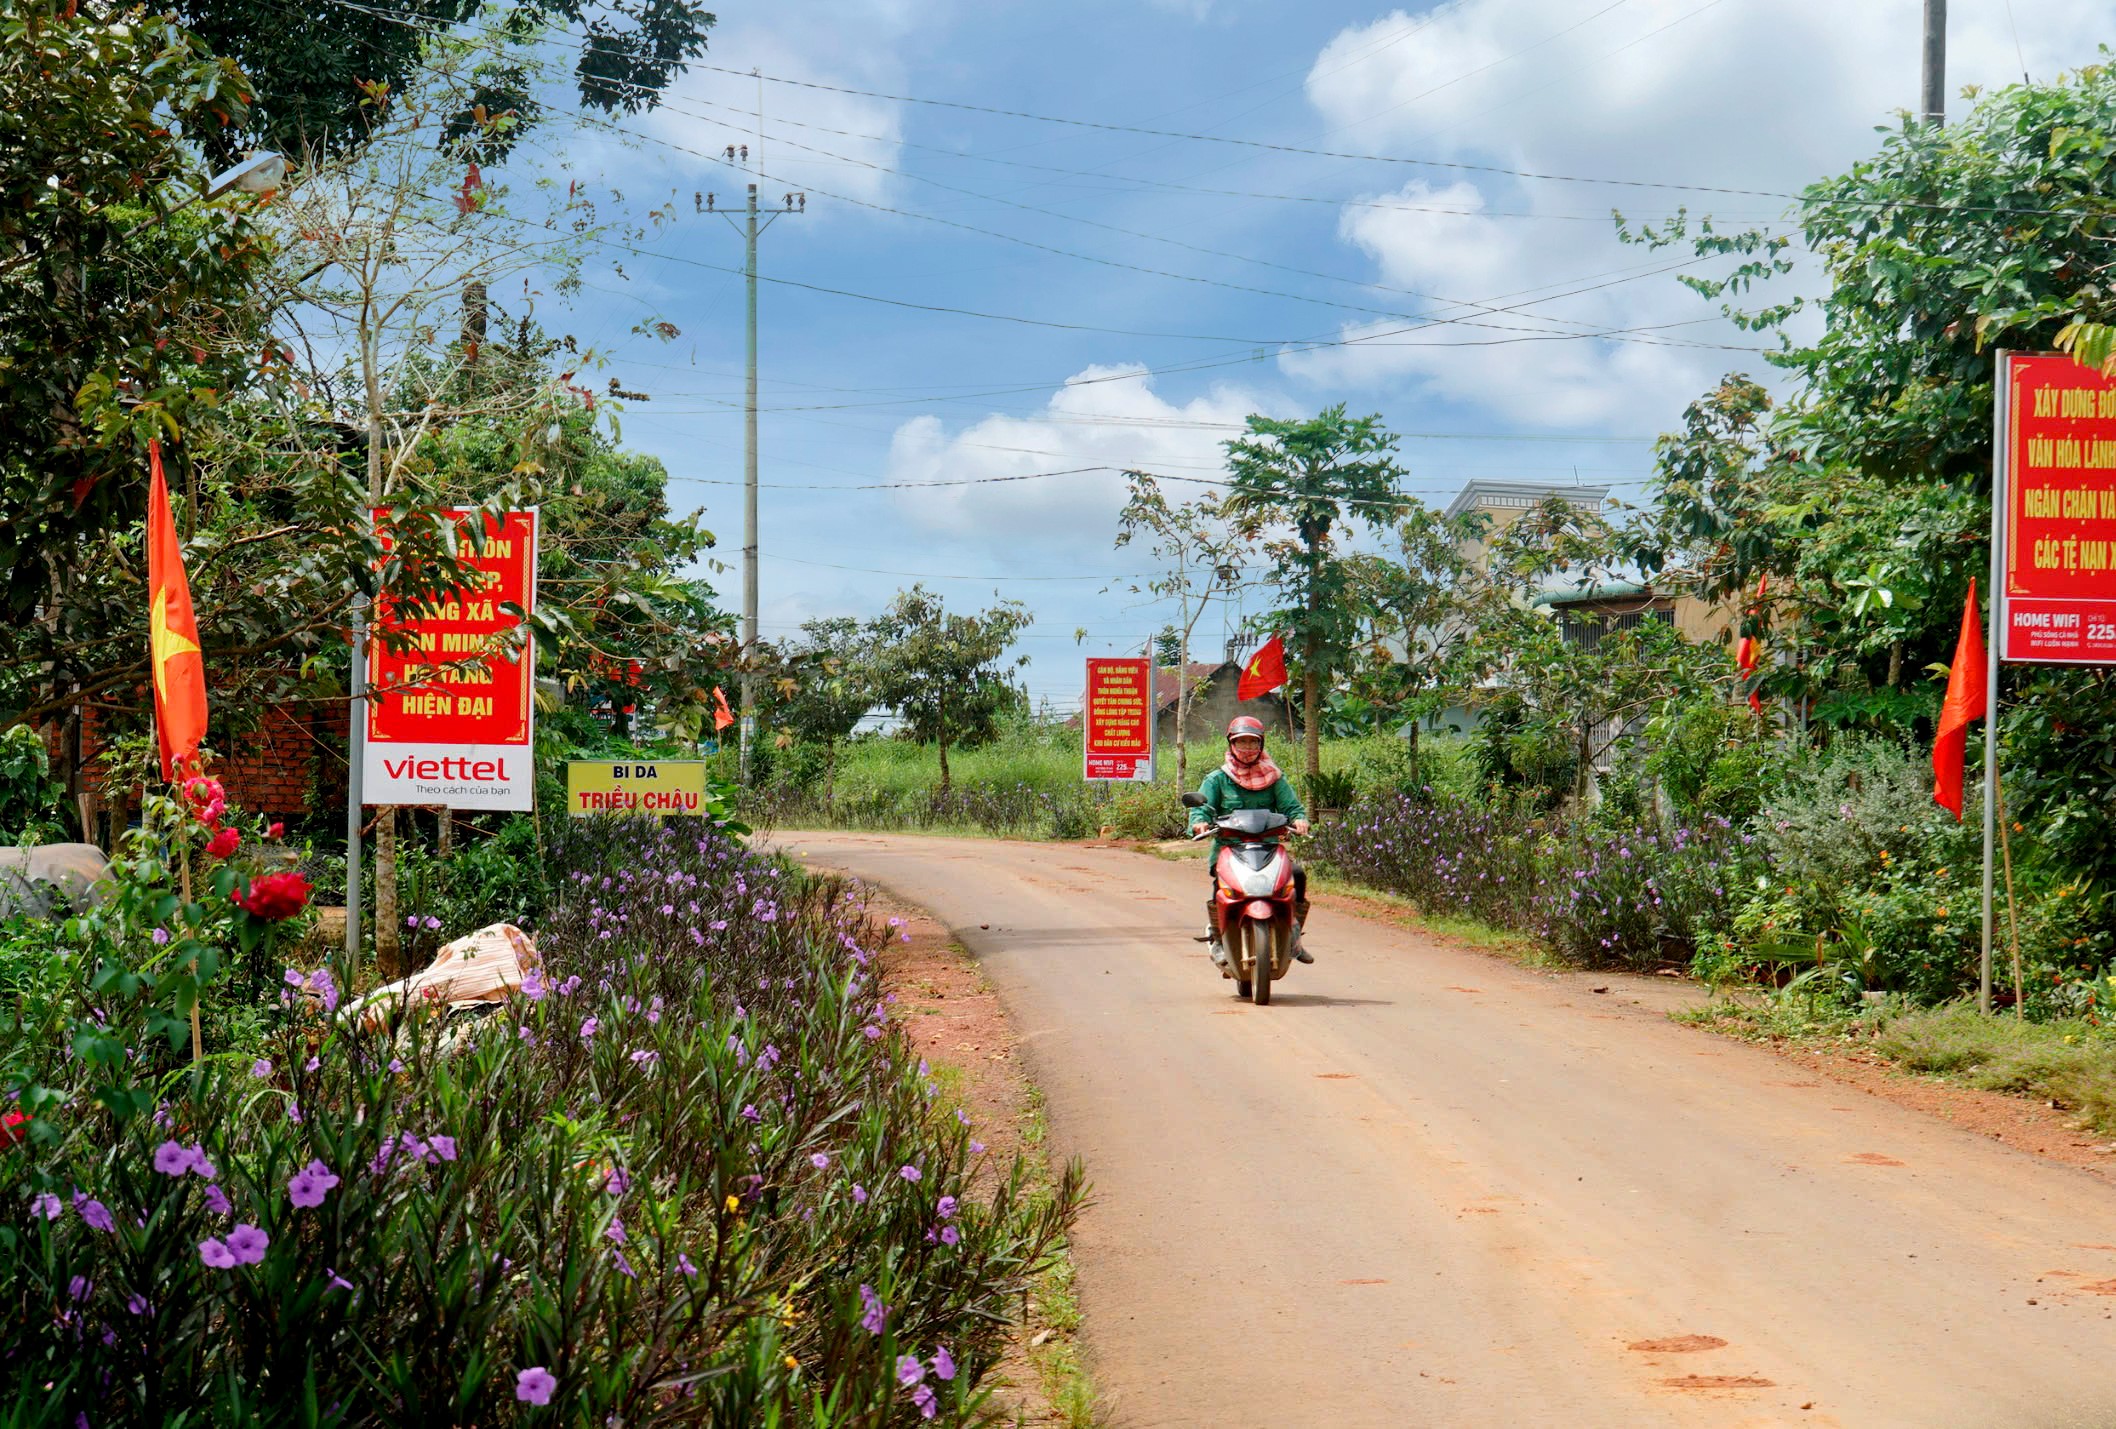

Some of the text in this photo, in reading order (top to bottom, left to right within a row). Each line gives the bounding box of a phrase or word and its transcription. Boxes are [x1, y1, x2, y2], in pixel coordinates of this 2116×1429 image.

[2034, 382, 2116, 425] XÂY DỰNG ĐỜ
[2028, 433, 2116, 469] VĂN HÓA LÀNH
[2024, 483, 2116, 526] NGĂN CHẶN VÀ
[2034, 534, 2060, 569] CÁC
[2063, 534, 2077, 576] TỆ
[2080, 541, 2107, 577] NẠN
[466, 599, 495, 621] XÃ
[2013, 613, 2081, 628] HOME WIFI
[402, 693, 493, 720] HIỆN ĐẠI
[384, 755, 510, 781] viettel
[613, 766, 657, 778] BI DA
[416, 785, 511, 796] Theo cách của bạn
[579, 785, 698, 809] TRIỀU CHÂU
